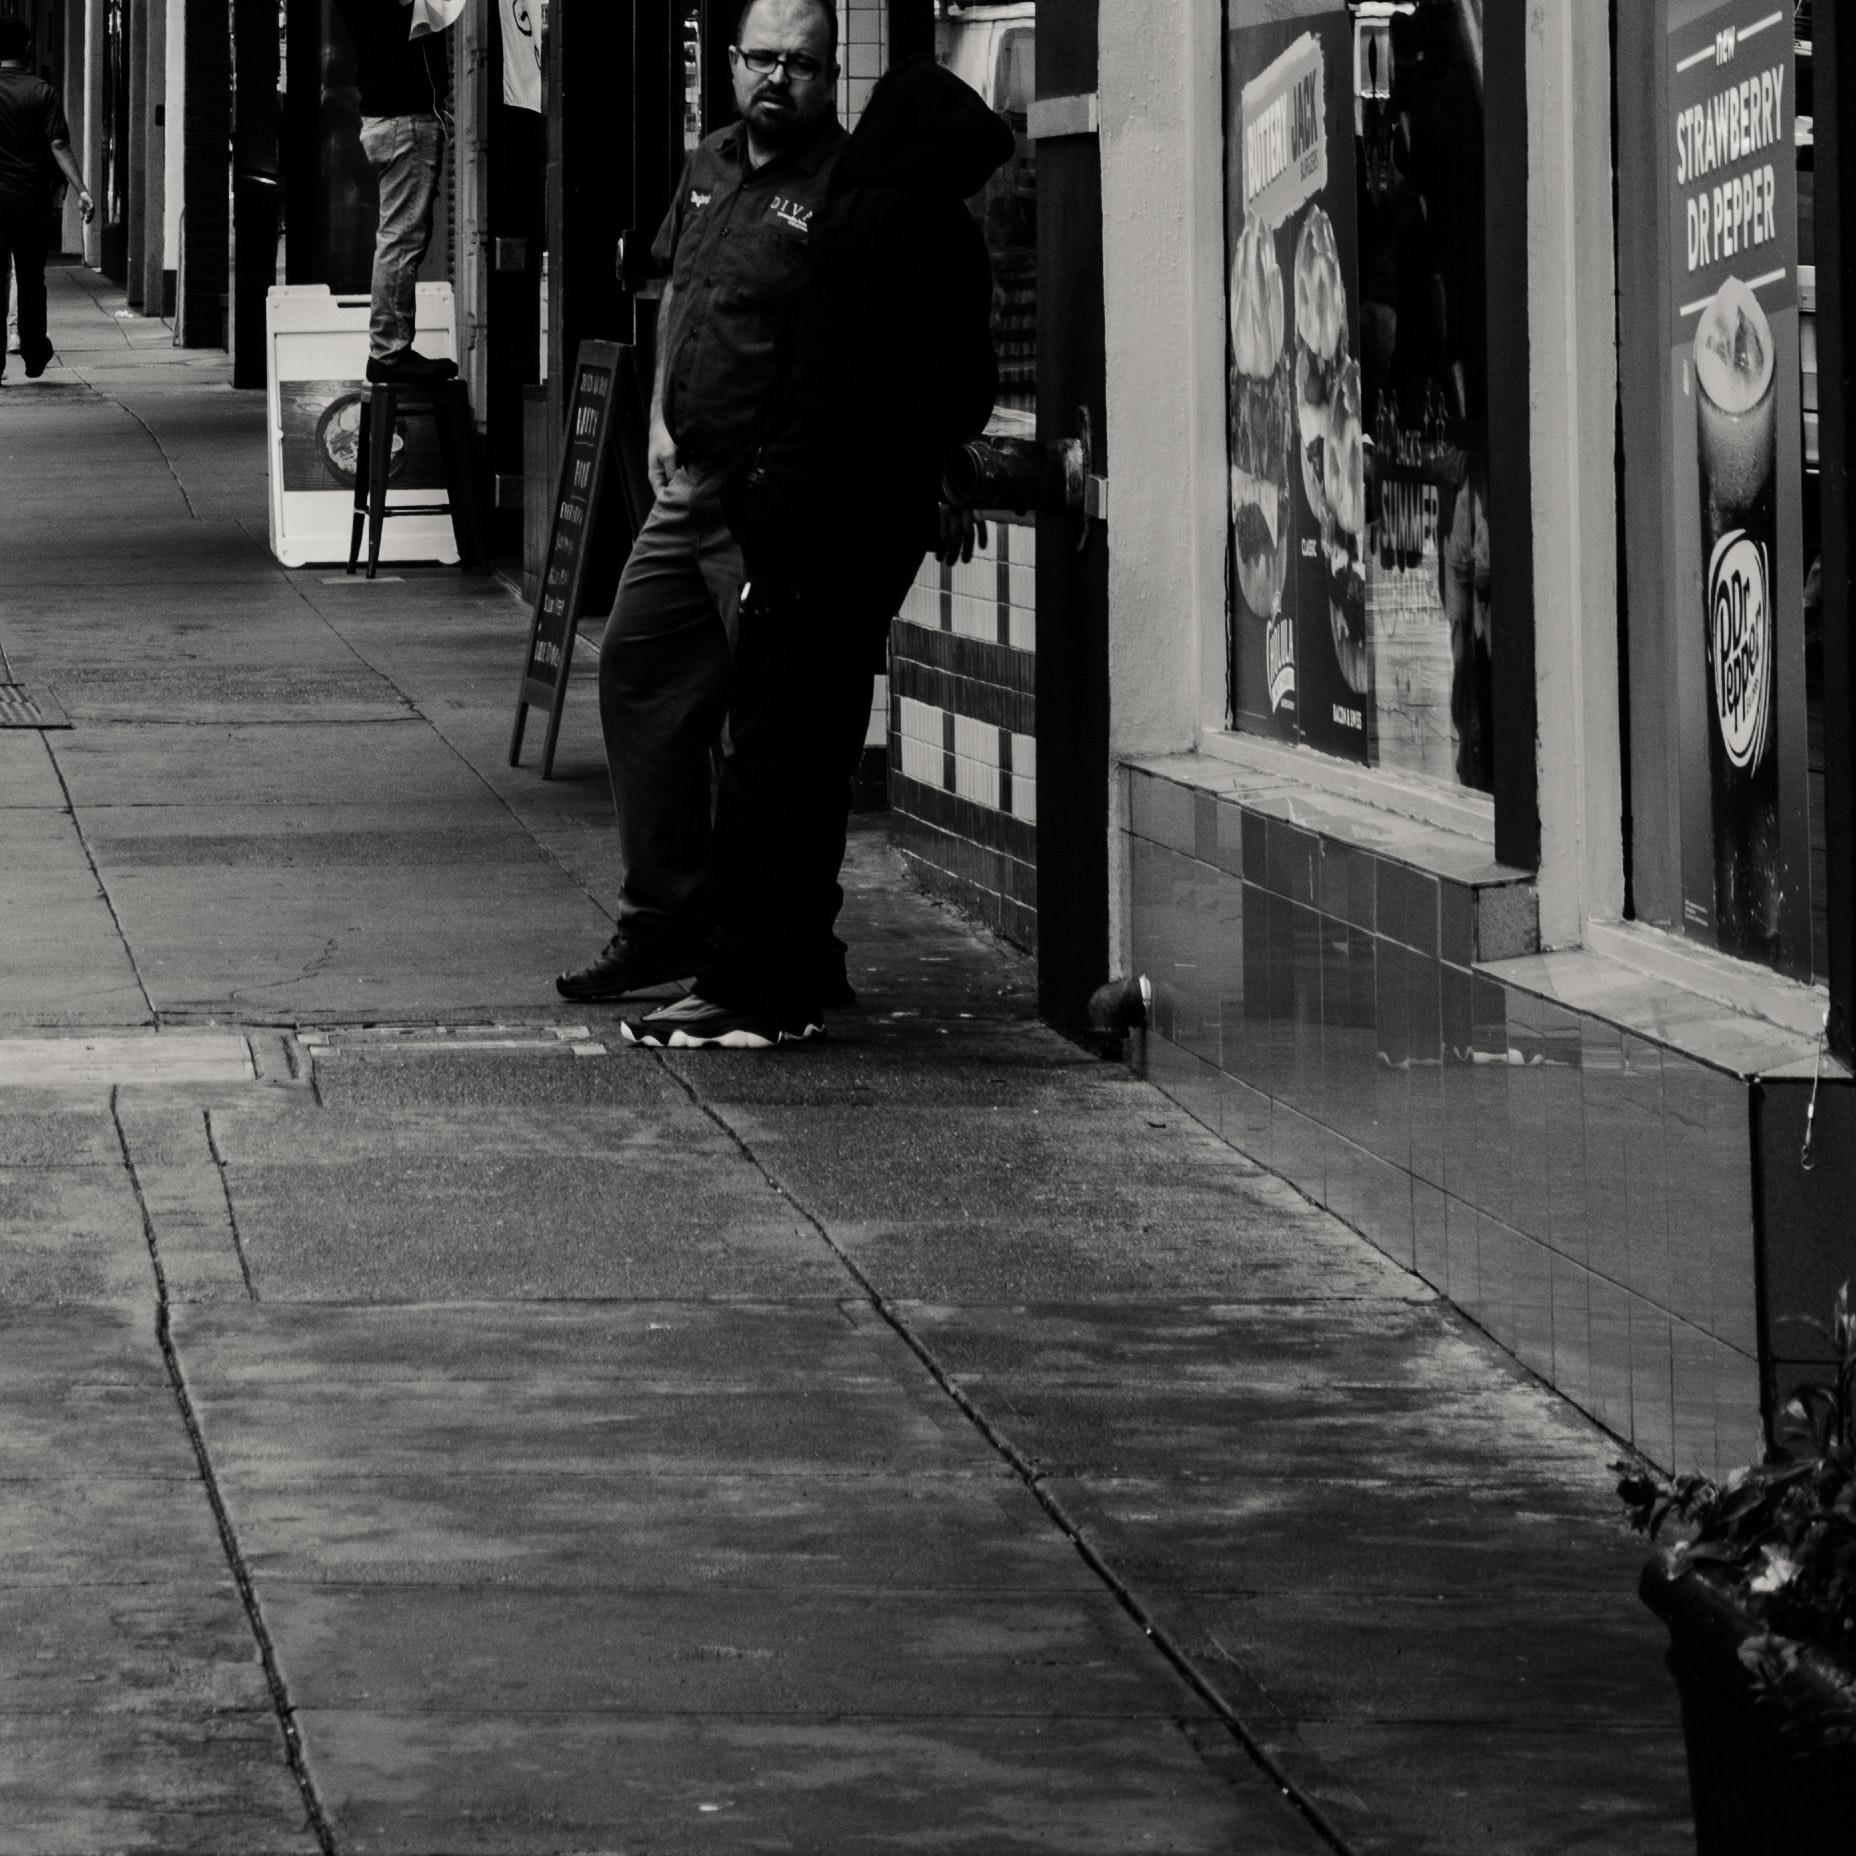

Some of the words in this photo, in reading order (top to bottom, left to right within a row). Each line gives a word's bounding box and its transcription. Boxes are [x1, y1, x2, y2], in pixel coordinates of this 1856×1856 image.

[1716, 23, 1737, 67] new
[1291, 67, 1318, 163] JACK
[1676, 63, 1786, 186] STRAWBERRY
[1687, 192, 1711, 273] DR
[1713, 163, 1776, 262] PEPPER
